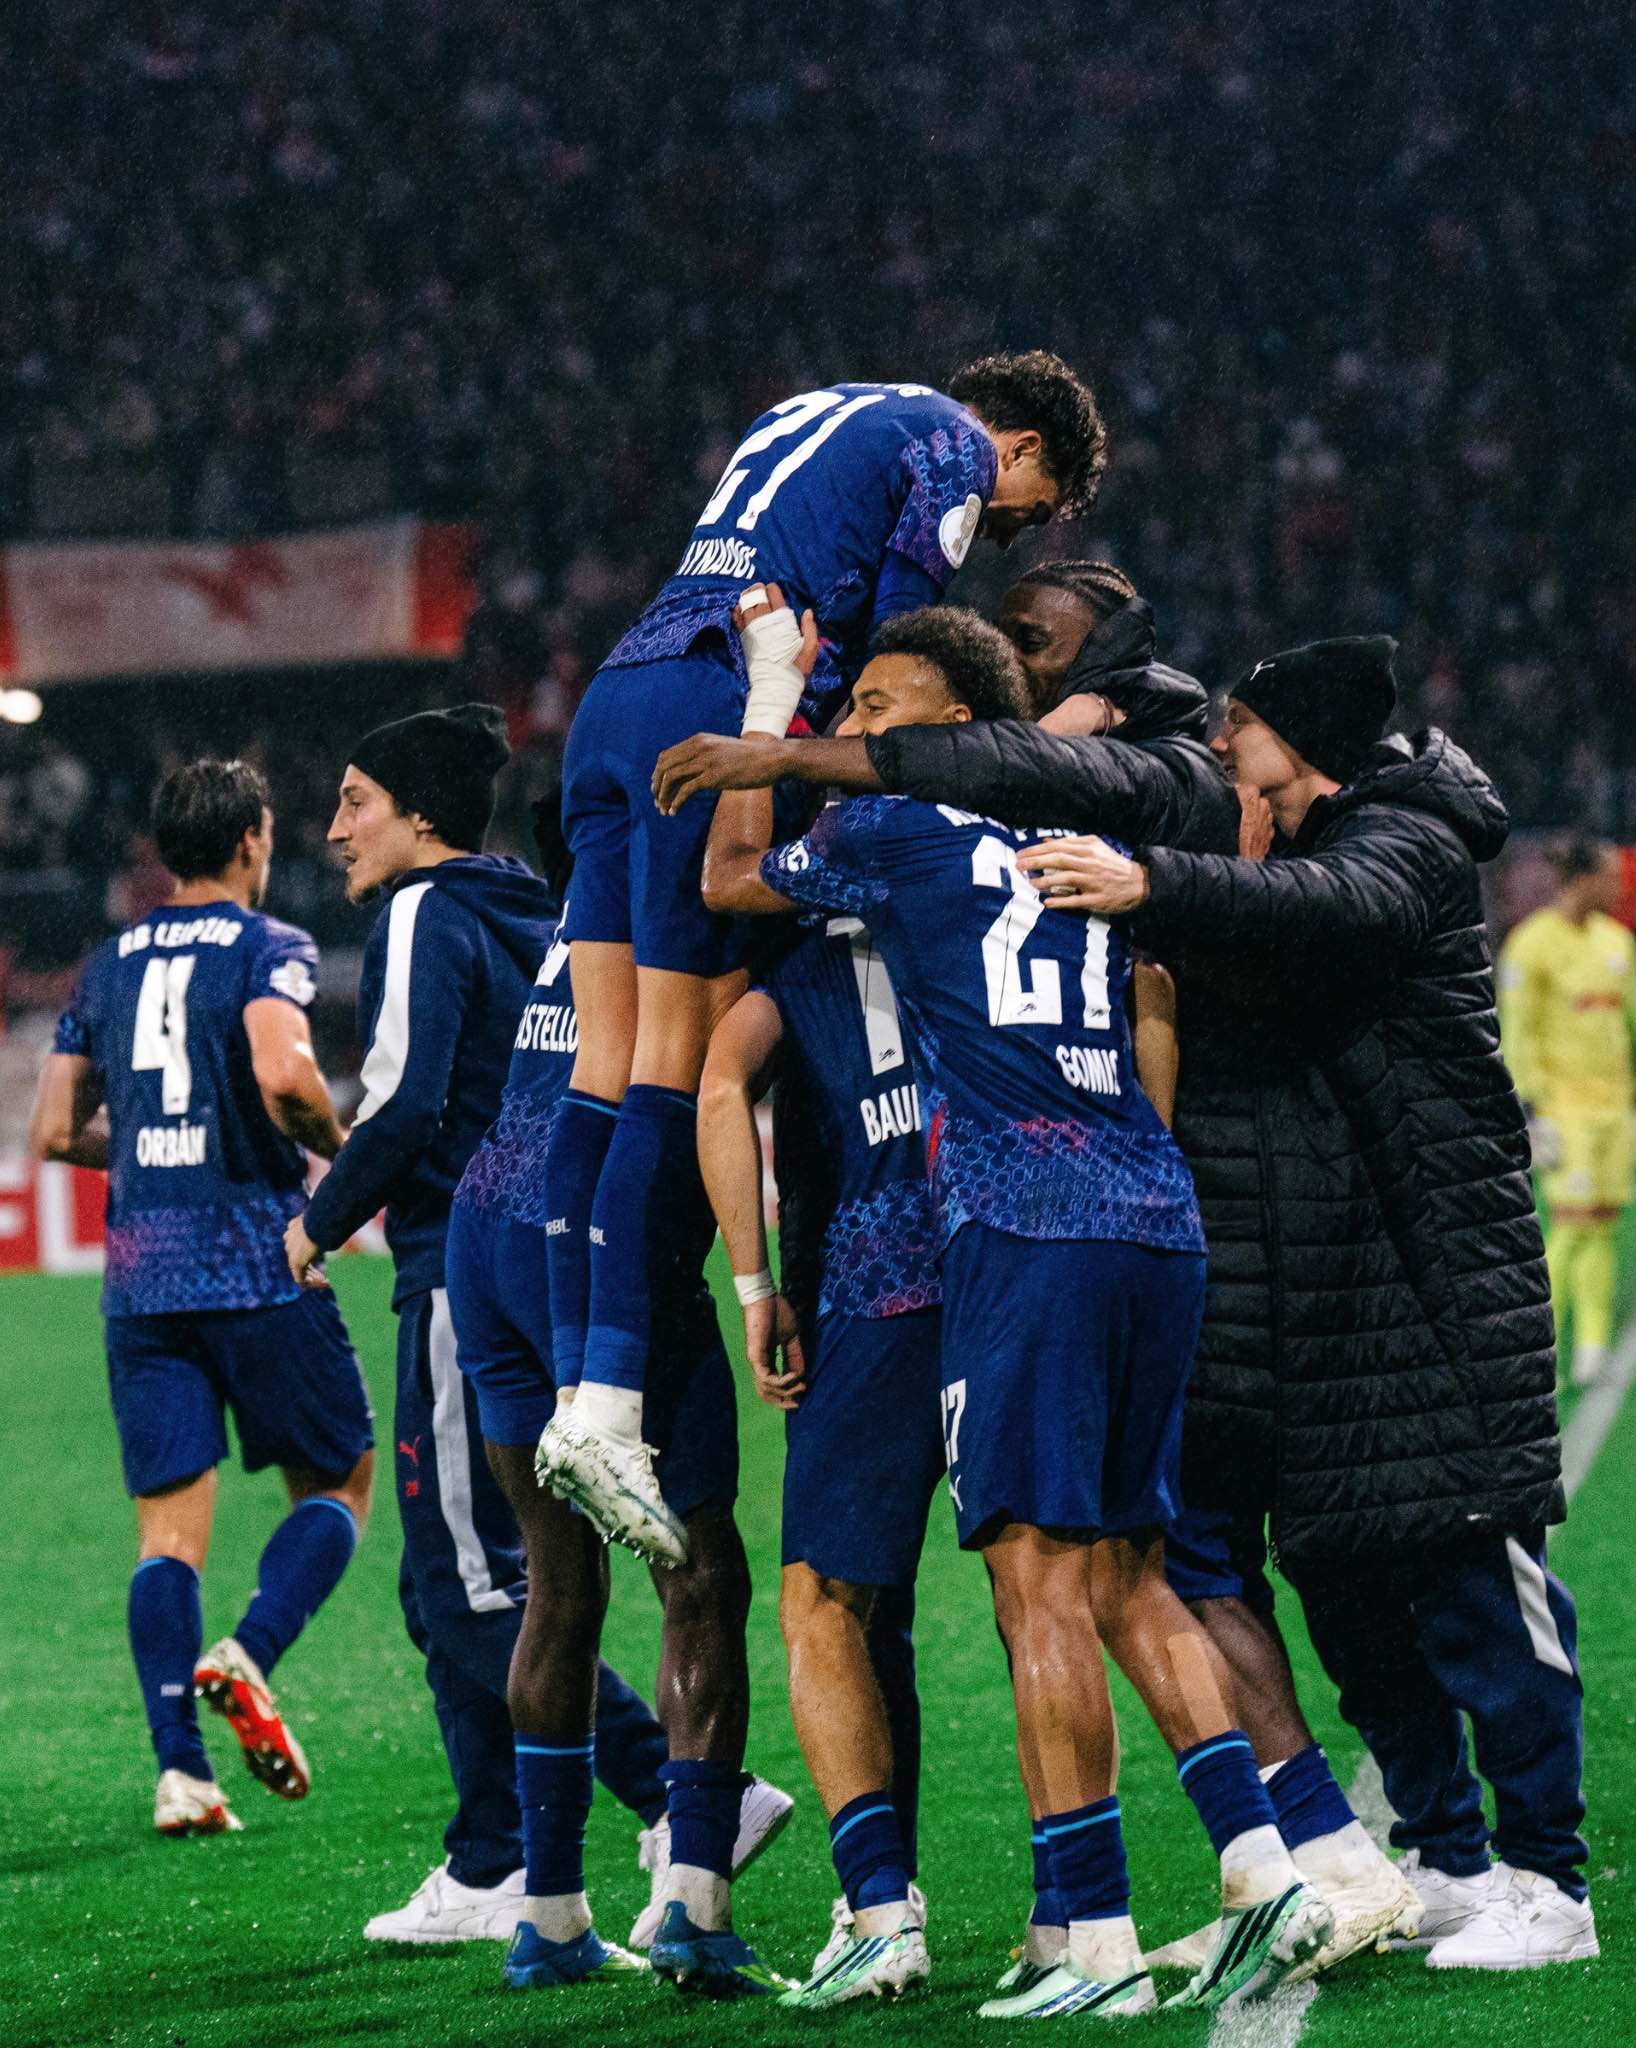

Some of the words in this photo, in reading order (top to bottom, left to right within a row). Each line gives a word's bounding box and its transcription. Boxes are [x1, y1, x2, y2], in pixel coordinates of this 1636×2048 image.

[118, 923, 152, 959] RB
[154, 916, 244, 949] LEIPZIG
[131, 953, 197, 1116] 4
[136, 1118, 207, 1168] ORBÁN
[940, 1377, 967, 1470] 7
